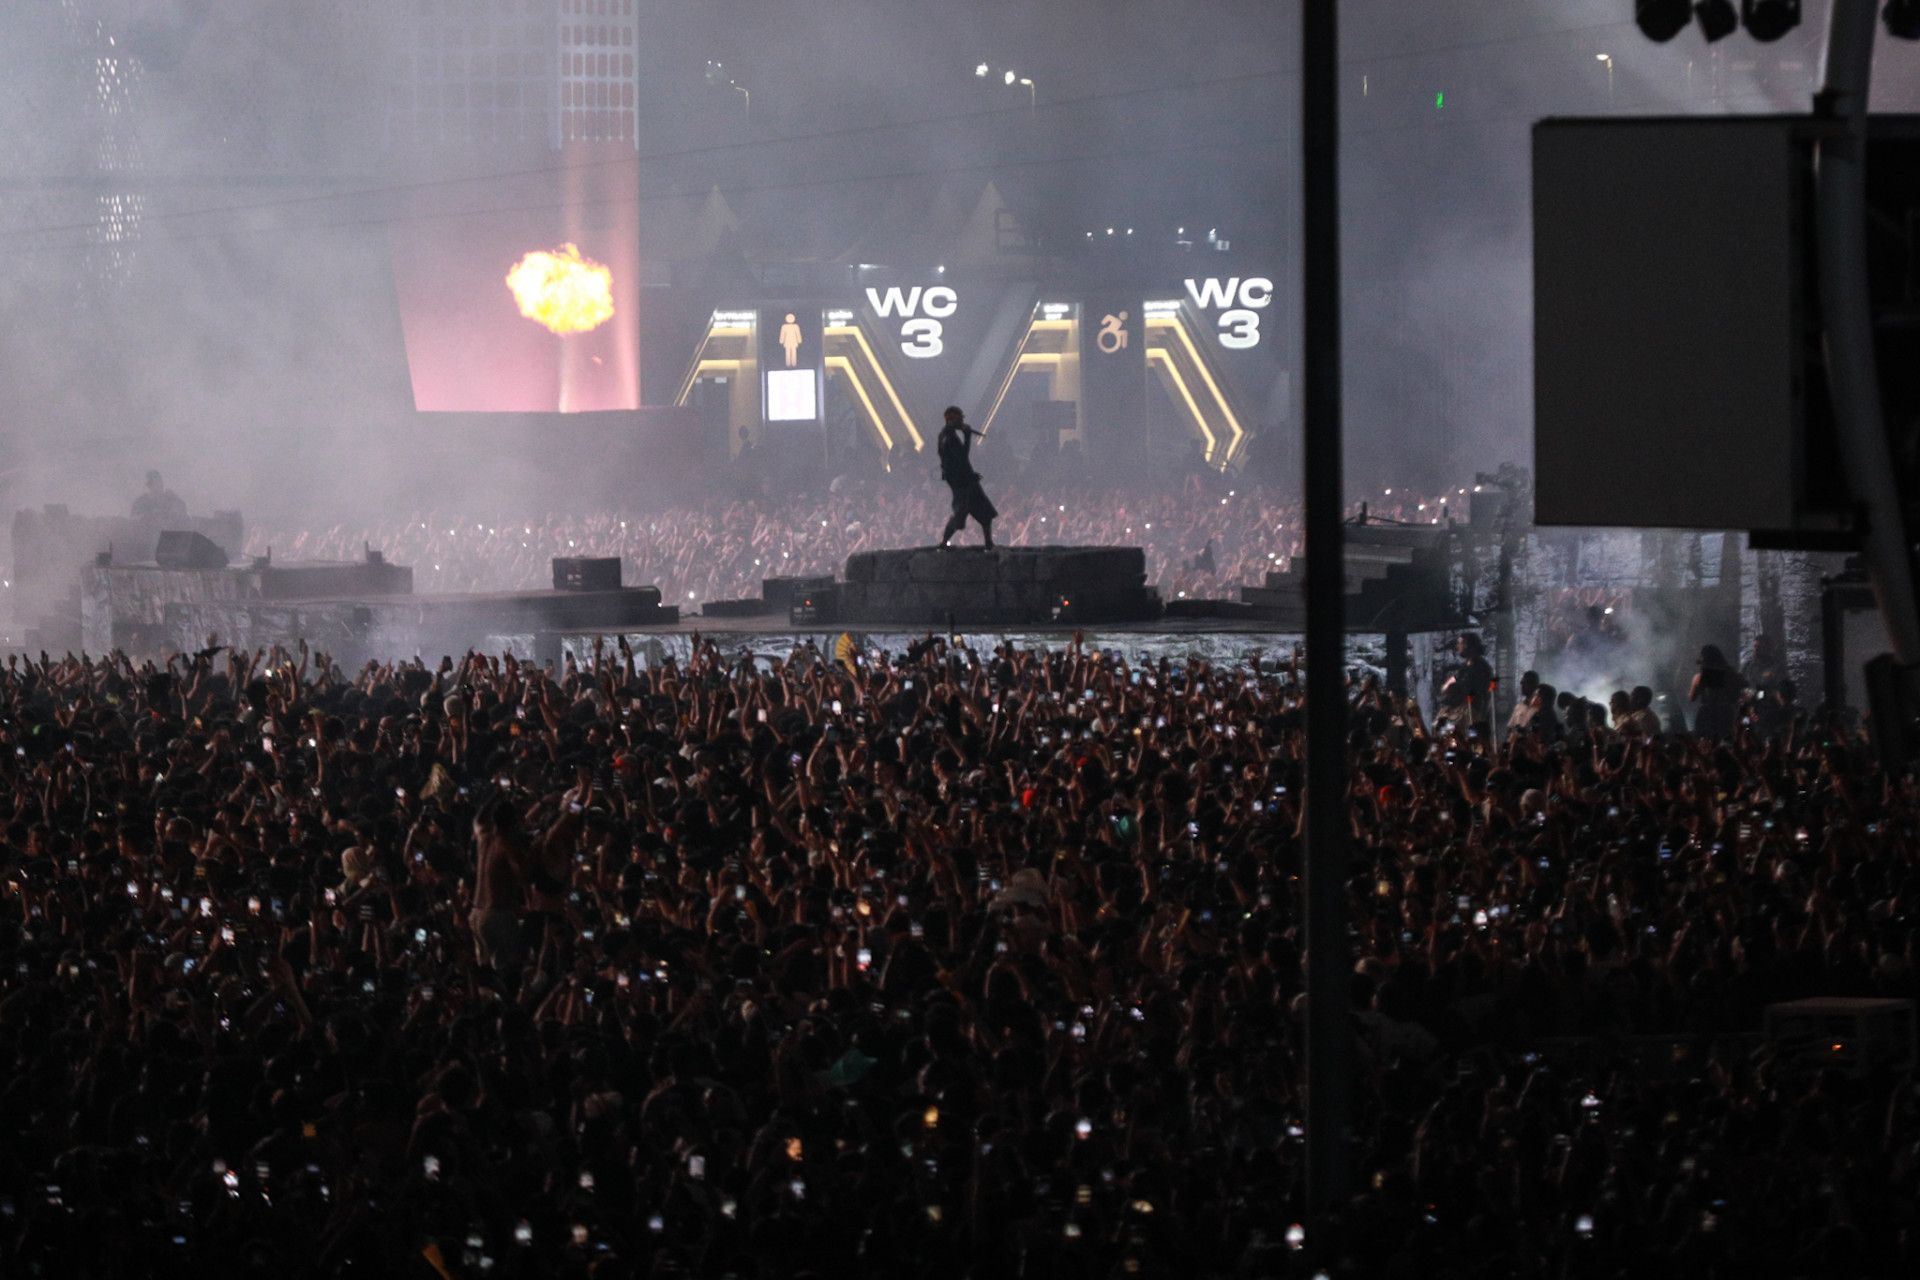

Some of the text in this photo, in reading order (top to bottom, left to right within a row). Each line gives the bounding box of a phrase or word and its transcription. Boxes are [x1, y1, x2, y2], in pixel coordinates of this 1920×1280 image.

[866, 286, 957, 317] WC
[1184, 278, 1273, 308] WC
[901, 318, 943, 358] 3
[1218, 309, 1260, 349] 3
